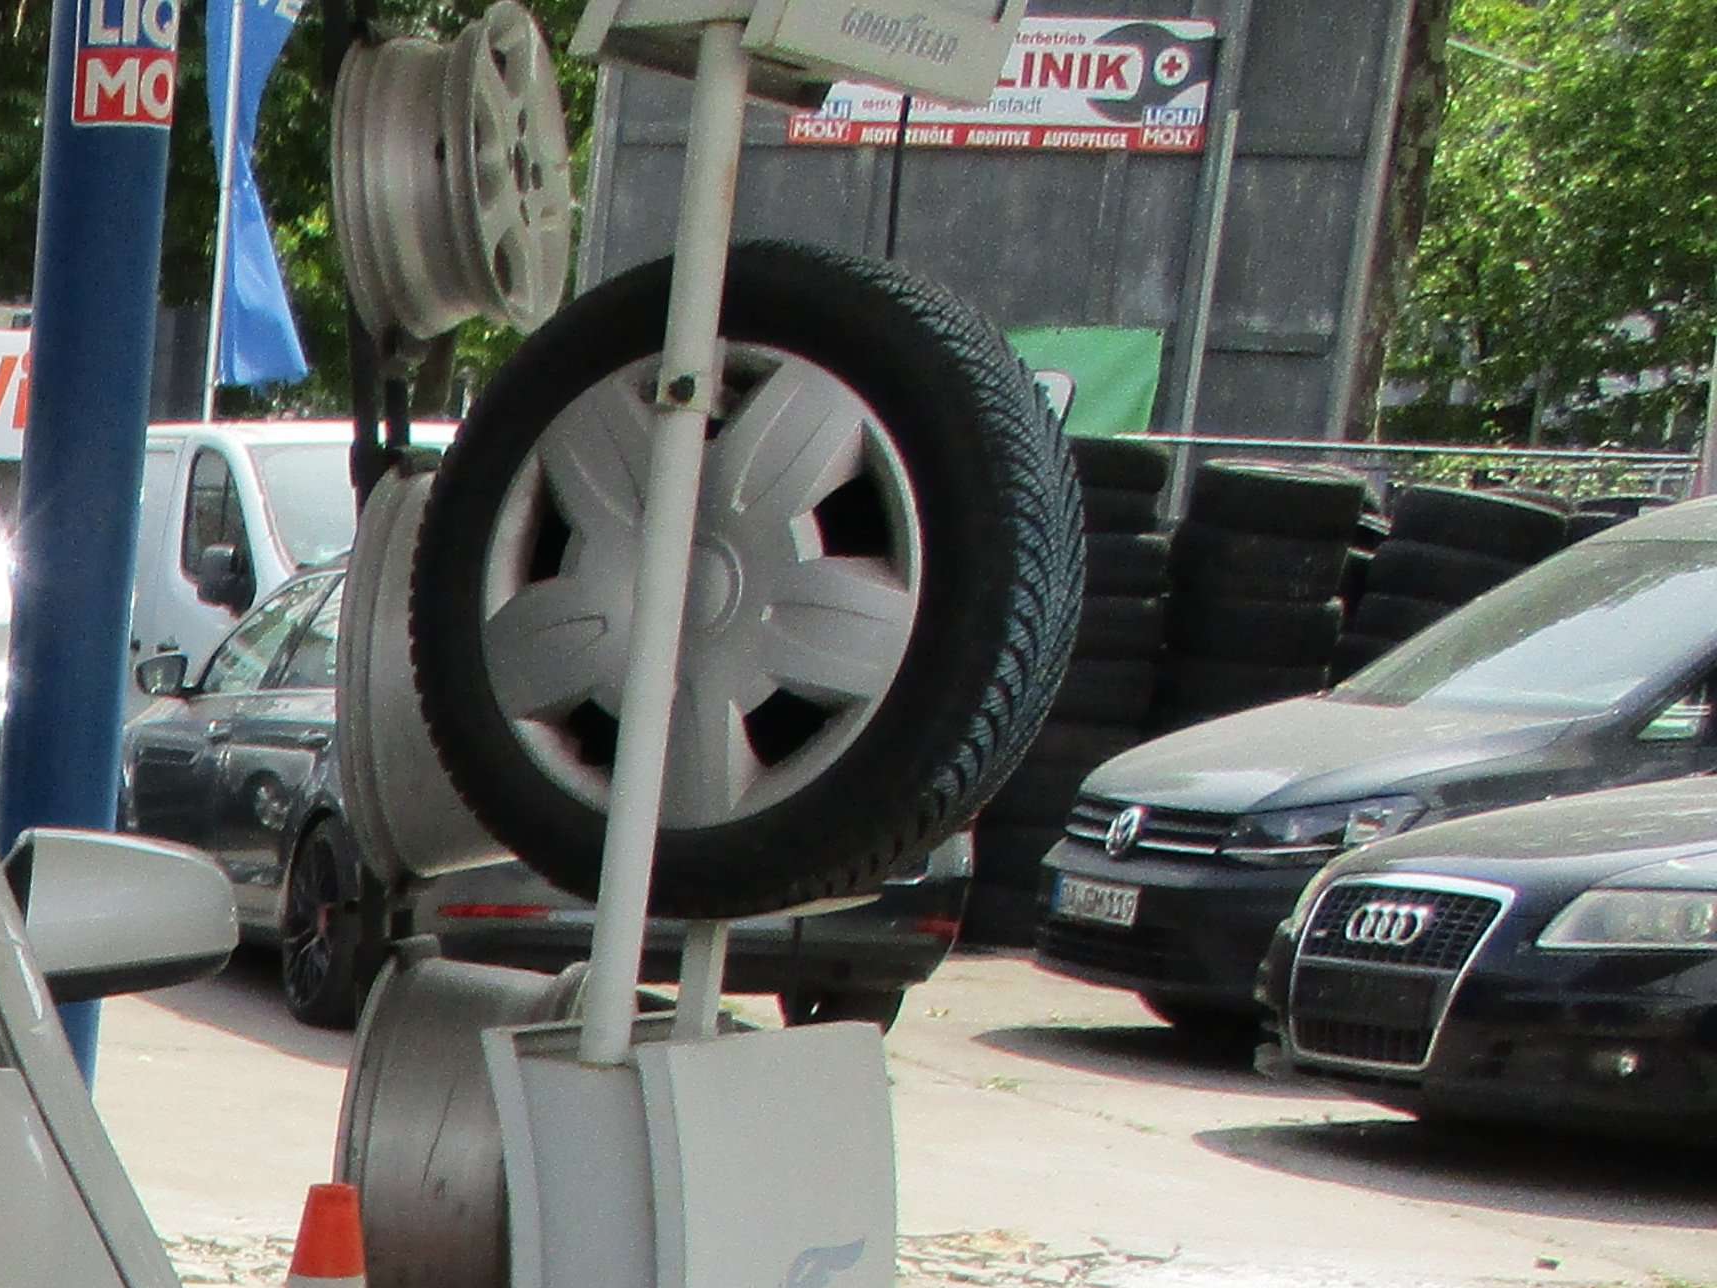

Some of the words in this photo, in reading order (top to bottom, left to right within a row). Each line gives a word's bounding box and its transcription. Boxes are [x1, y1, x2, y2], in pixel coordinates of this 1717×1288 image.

[997, 52, 1129, 90] INIK
[793, 119, 849, 139] MOLY
[965, 129, 1031, 146] ADDITIVE
[1042, 131, 1129, 148] AUTOPFLEGE
[1142, 128, 1196, 146] MOLY
